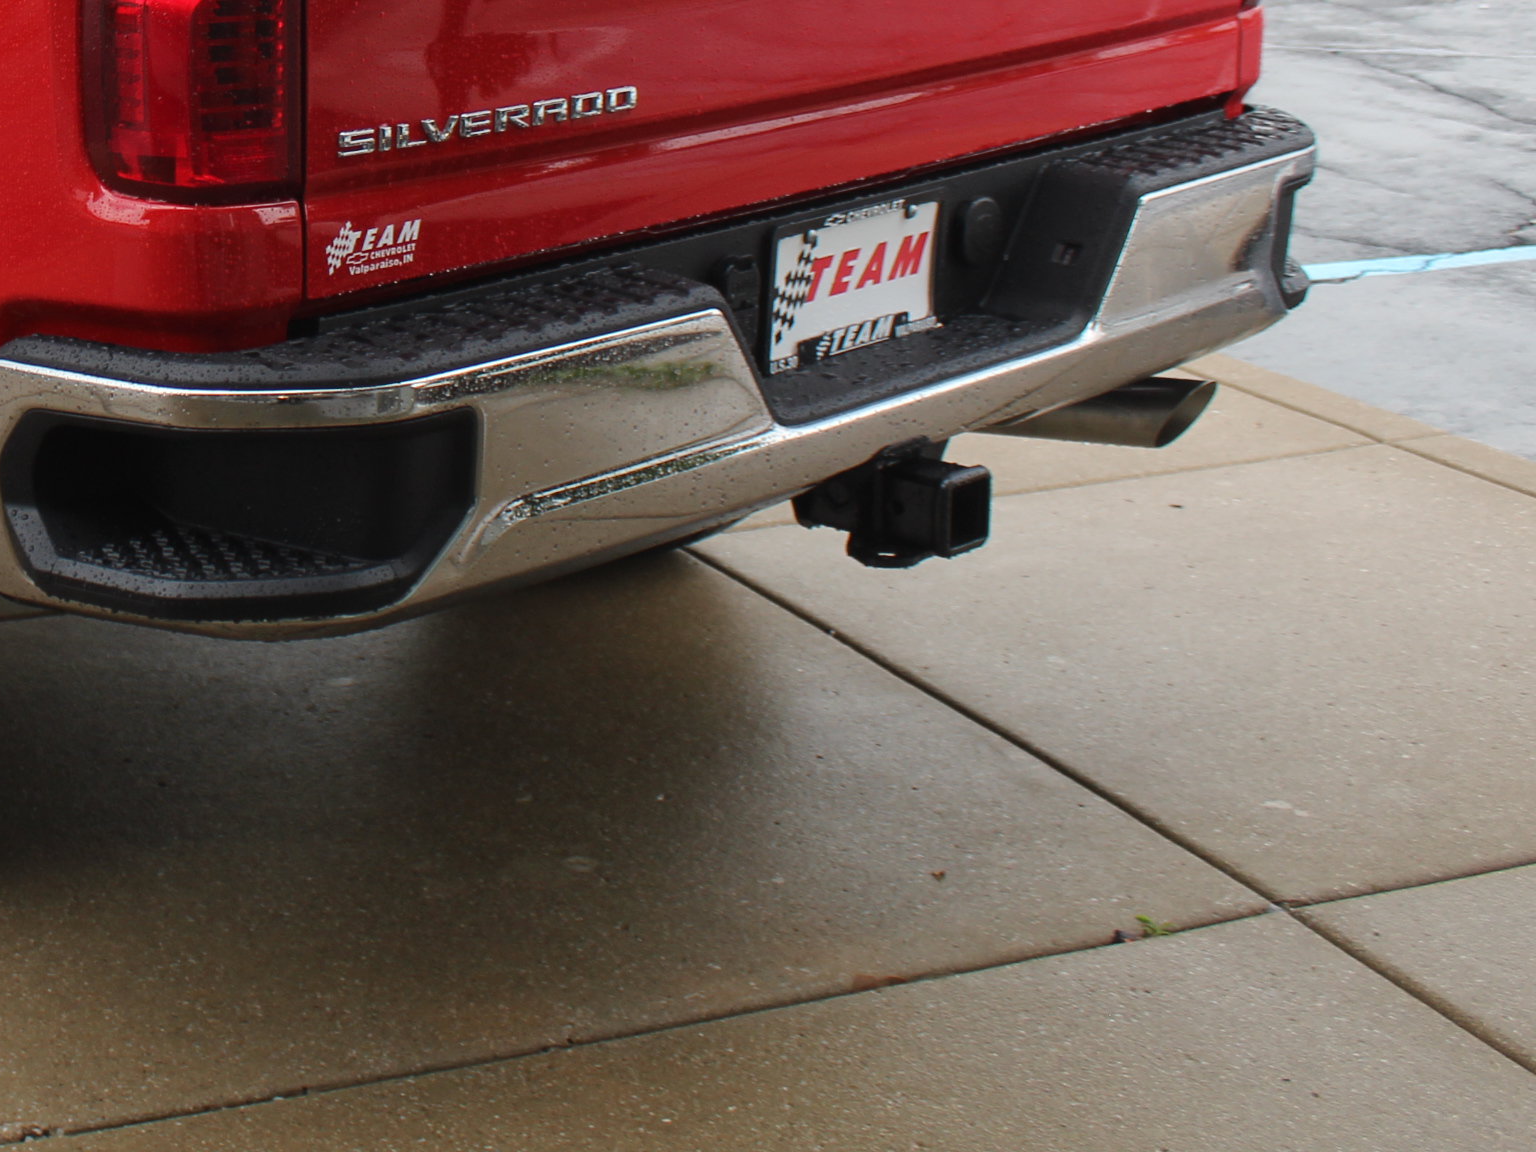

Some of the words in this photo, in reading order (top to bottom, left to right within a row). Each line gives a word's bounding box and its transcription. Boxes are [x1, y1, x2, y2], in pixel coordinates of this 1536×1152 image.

[337, 85, 638, 158] SILVERADO
[347, 218, 422, 254] TEAM
[370, 242, 417, 259] CHEVROLET
[349, 258, 402, 276] Valparaiso,
[402, 253, 414, 264] IN
[805, 231, 930, 303] TEAM
[829, 314, 895, 354] TEAM
